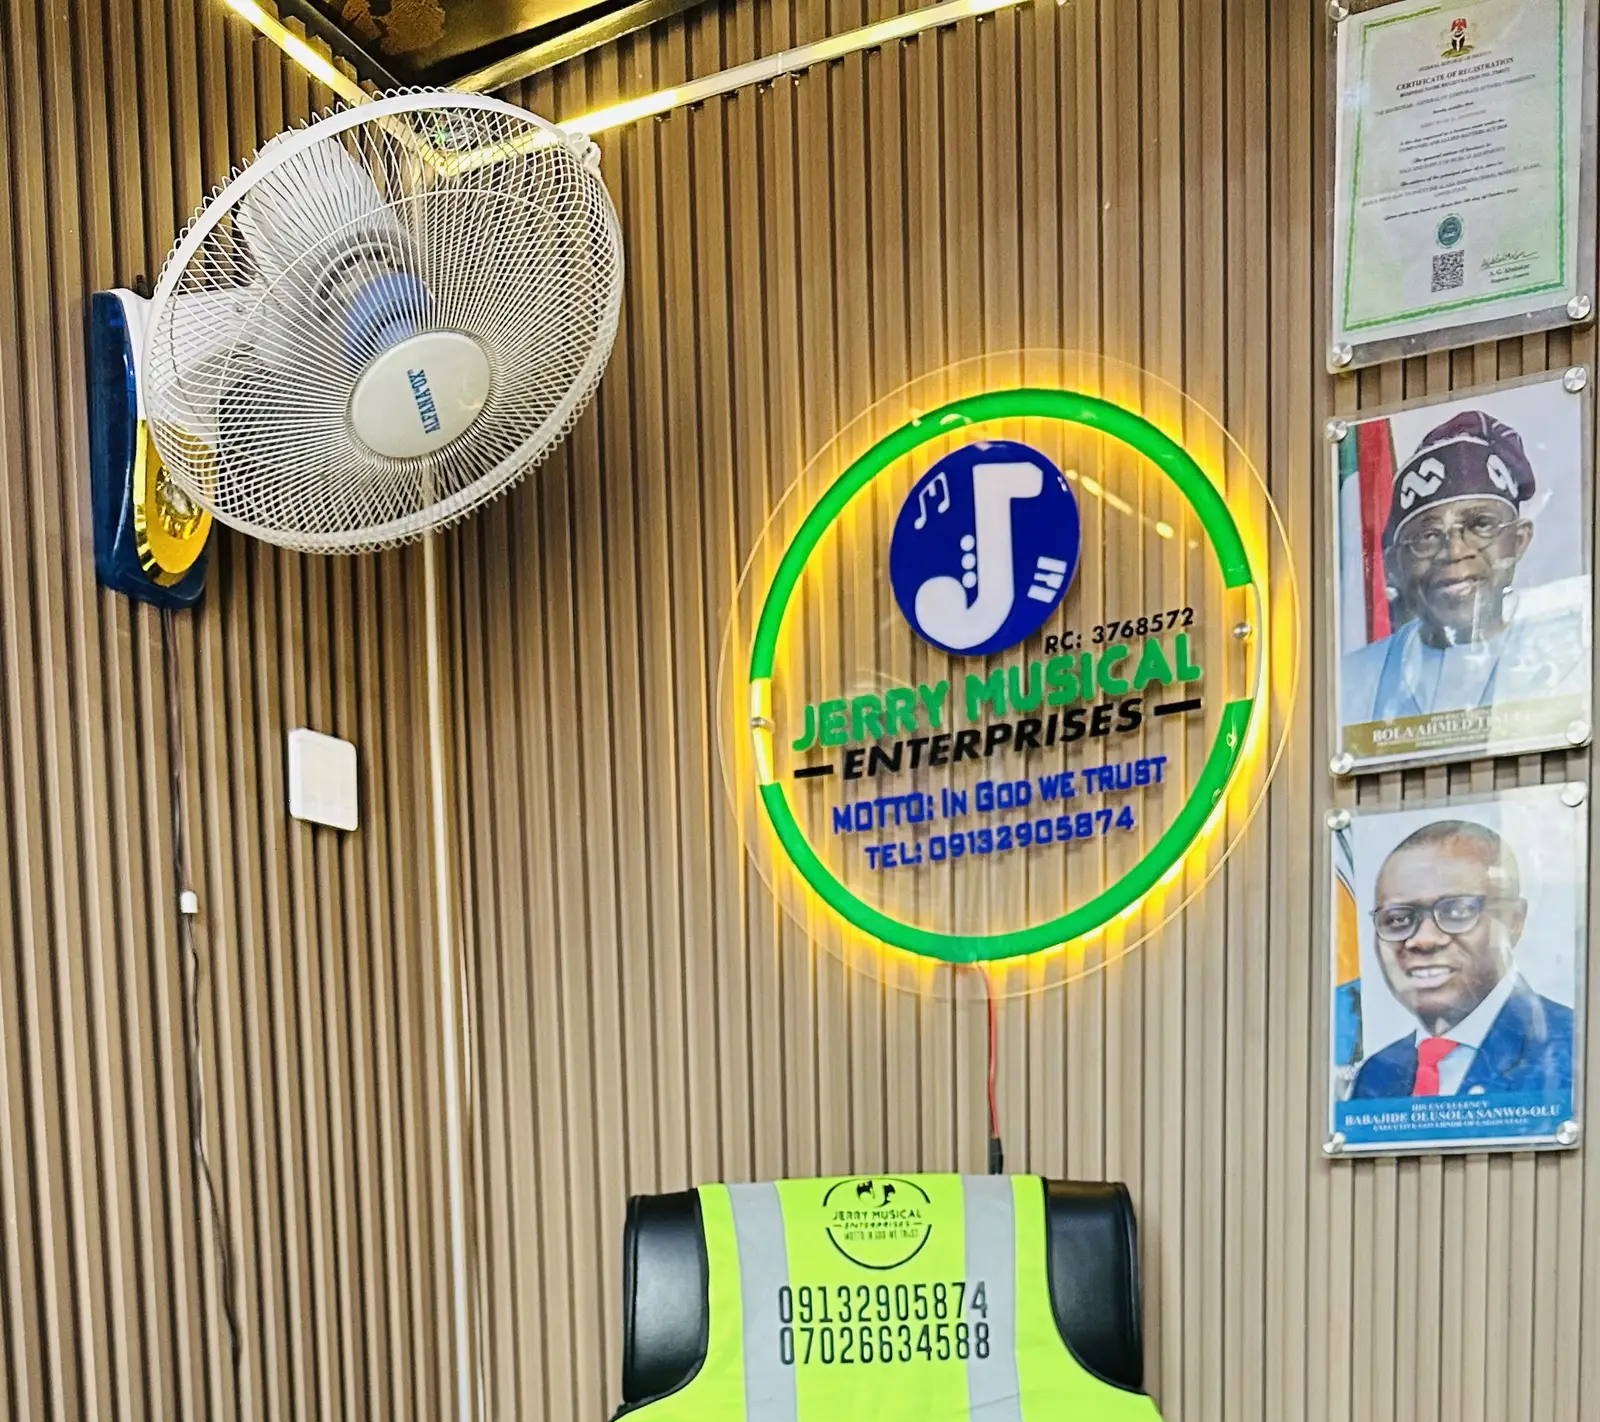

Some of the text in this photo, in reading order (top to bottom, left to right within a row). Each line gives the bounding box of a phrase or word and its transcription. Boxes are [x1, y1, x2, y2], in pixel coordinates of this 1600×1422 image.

[1396, 73, 1445, 91] CERTIFICATE
[1447, 70, 1457, 79] OF
[1458, 57, 1515, 76] REGISTRATION
[1044, 606, 1195, 655] RC: 3768572
[791, 633, 1202, 752] JERRY MUSICAL
[843, 698, 1143, 781] ENTERPRISES
[1372, 727, 1414, 744] BOLA
[1416, 718, 1475, 738] AHMED
[831, 792, 934, 836] MOTTO:
[1083, 755, 1168, 793] TRUST
[864, 805, 1135, 871] TEL: 09132905874
[1345, 1103, 1560, 1126] BABAJIDE OLUSOLA SANWO-OLU
[832, 1208, 922, 1221] JERRY MUSICAL
[844, 1221, 910, 1230] ENTERPRISES
[778, 1281, 989, 1324] 09132905874
[779, 1322, 991, 1366] 07026634588
